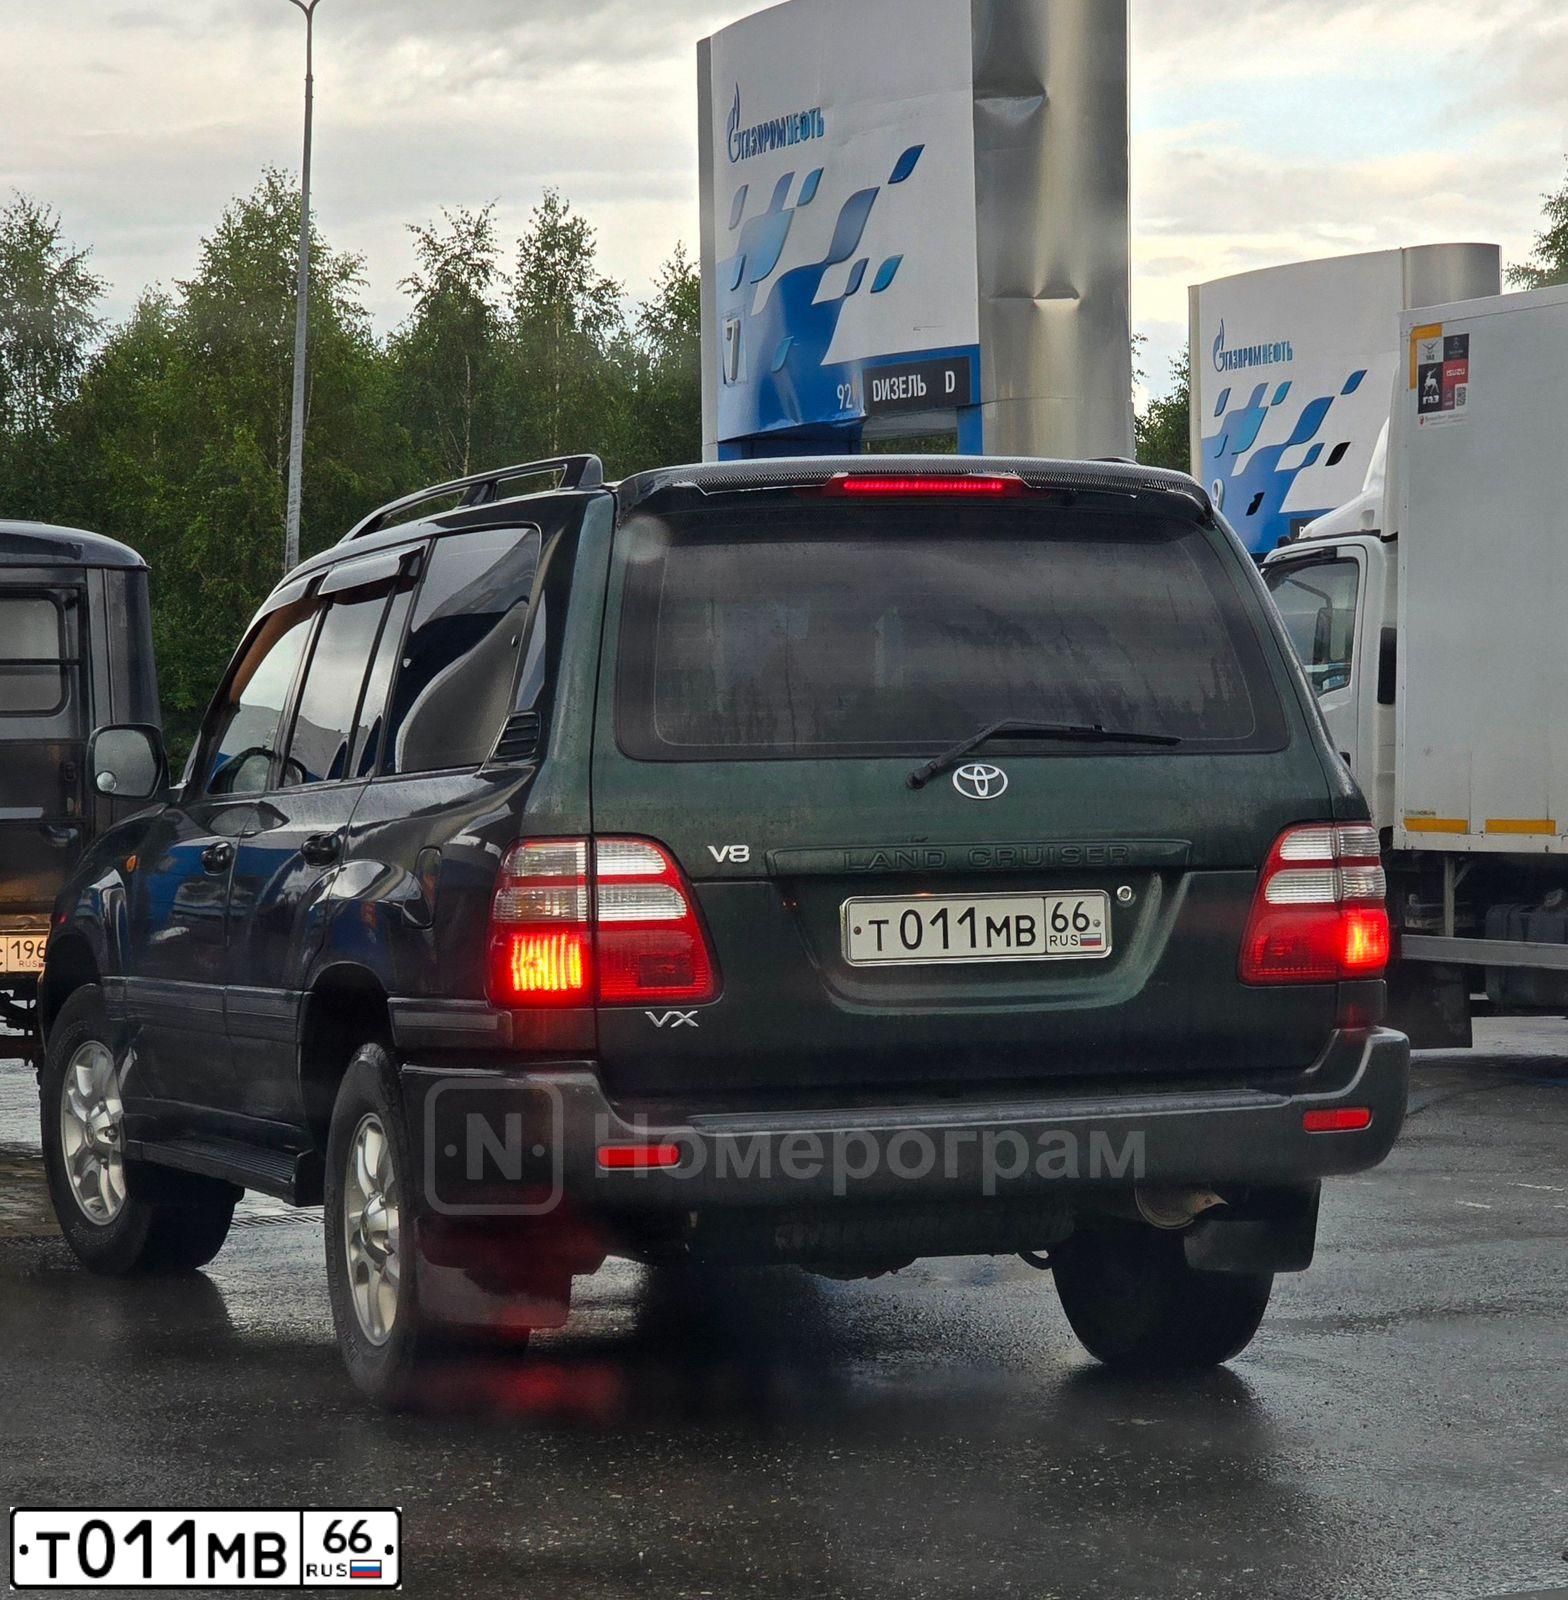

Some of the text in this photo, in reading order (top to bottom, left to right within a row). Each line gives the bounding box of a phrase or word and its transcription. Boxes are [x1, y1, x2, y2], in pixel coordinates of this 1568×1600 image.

[945, 371, 956, 394] D
[836, 384, 853, 410] 92
[709, 844, 751, 863] V8
[844, 845, 1131, 871] LAND CRUISER
[1051, 901, 1091, 933] 66
[10, 940, 46, 960] 196
[1049, 935, 1079, 947] RUS
[18, 960, 38, 968] RUS
[645, 1010, 699, 1028] VX
